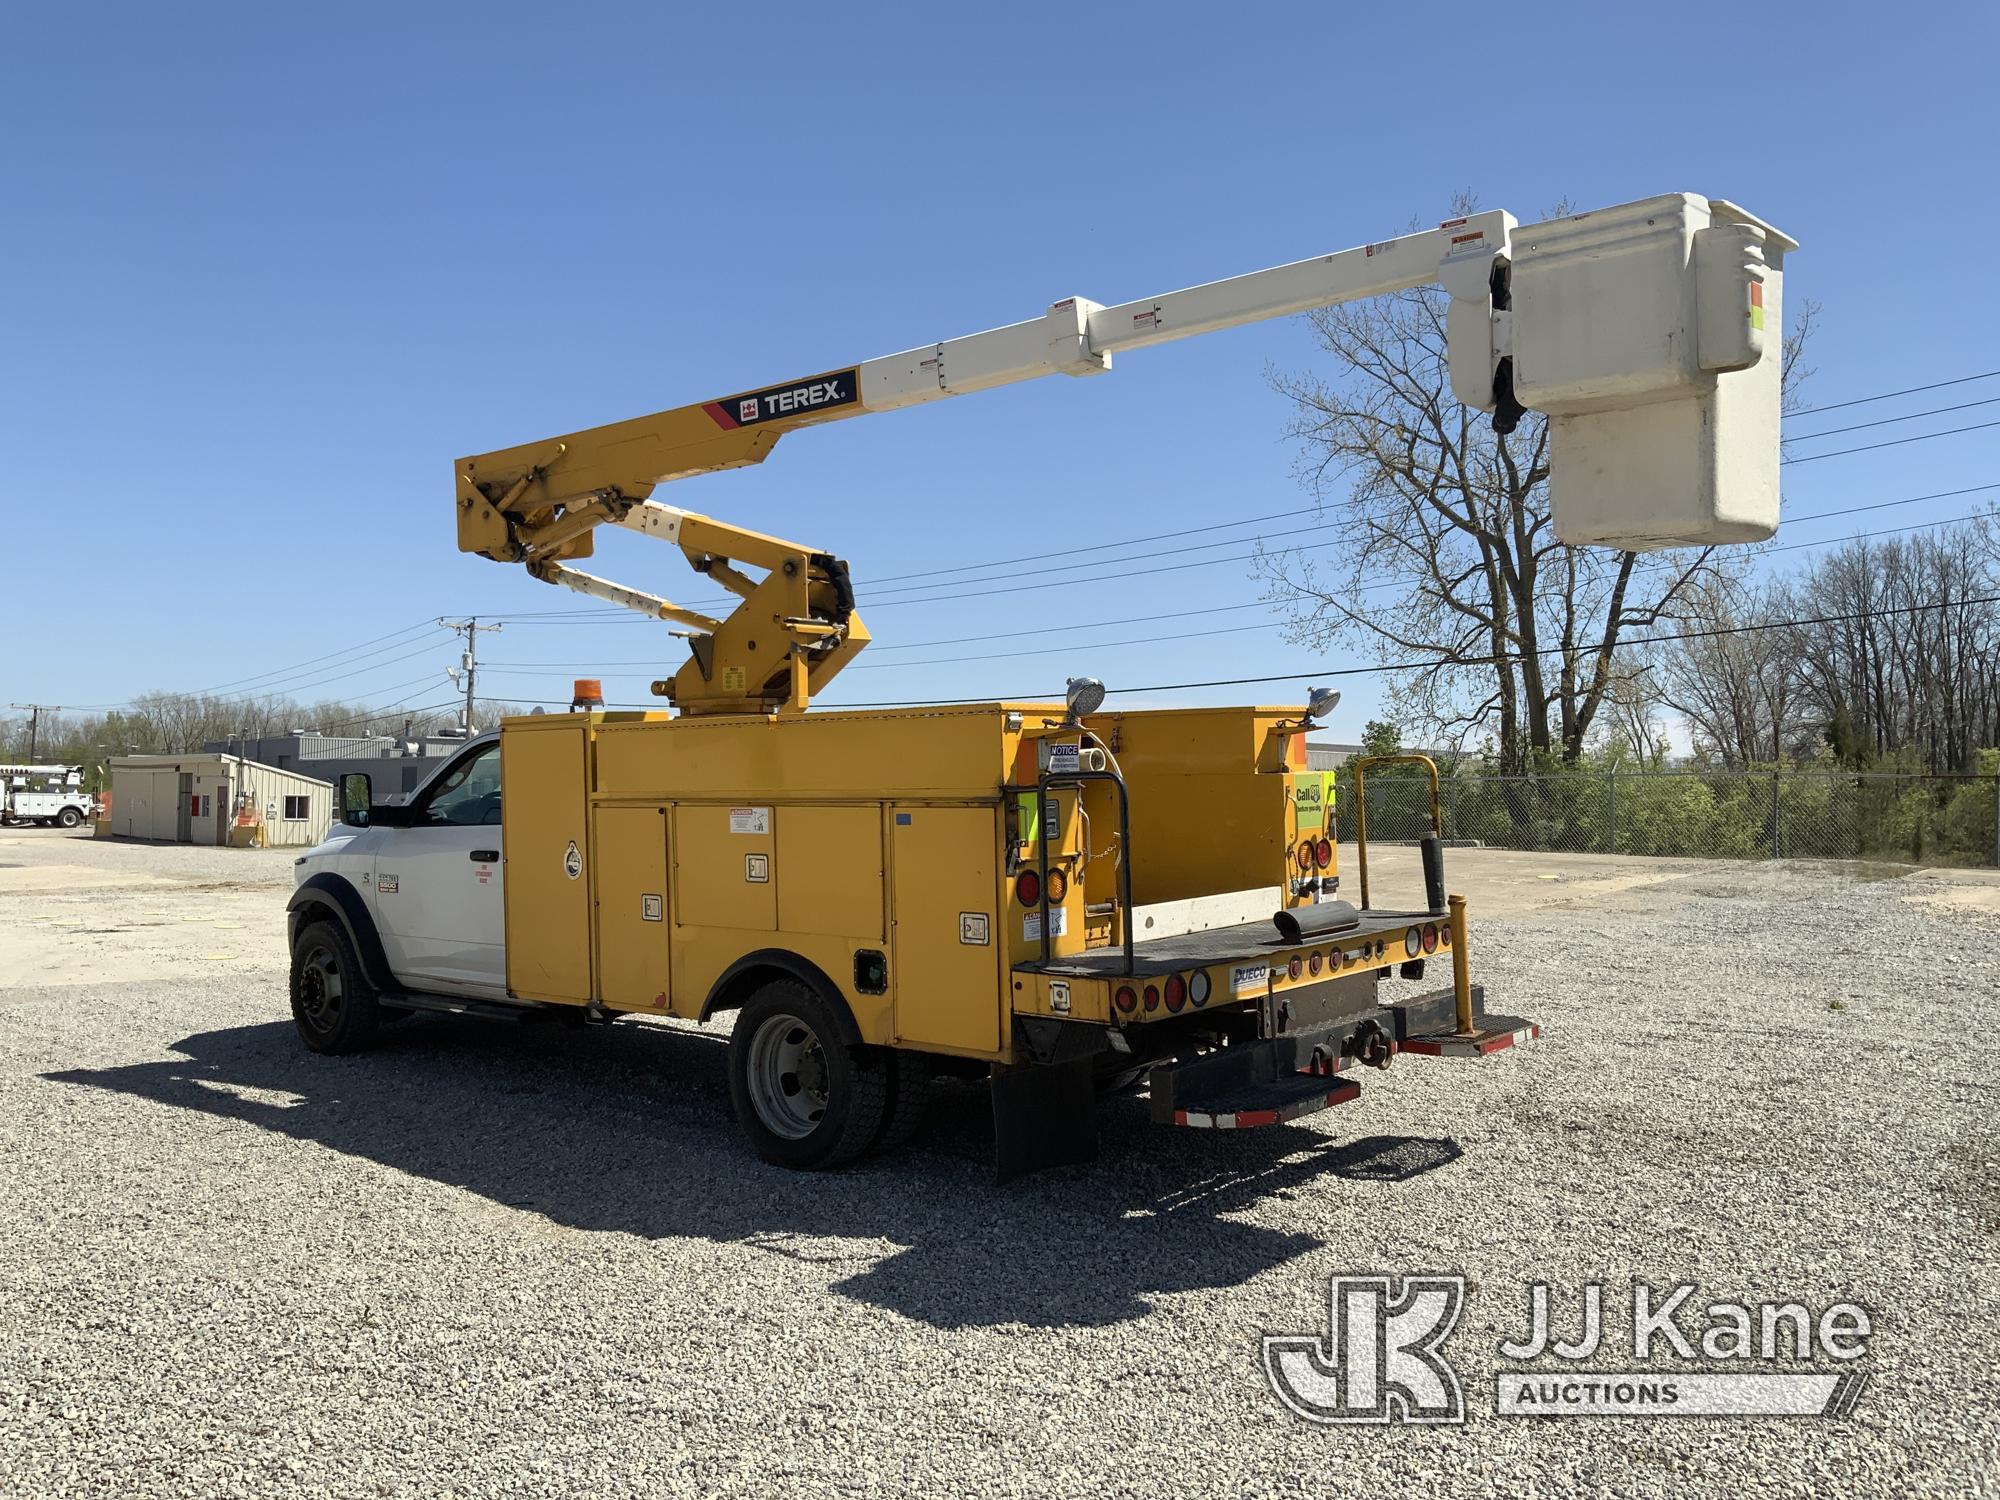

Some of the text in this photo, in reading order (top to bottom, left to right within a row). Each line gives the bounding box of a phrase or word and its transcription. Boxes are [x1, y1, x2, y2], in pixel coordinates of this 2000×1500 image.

[764, 380, 840, 414] TEREX
[1051, 746, 1077, 755] NOTICE
[1296, 788, 1310, 802] Call
[1233, 967, 1266, 984] DUECO
